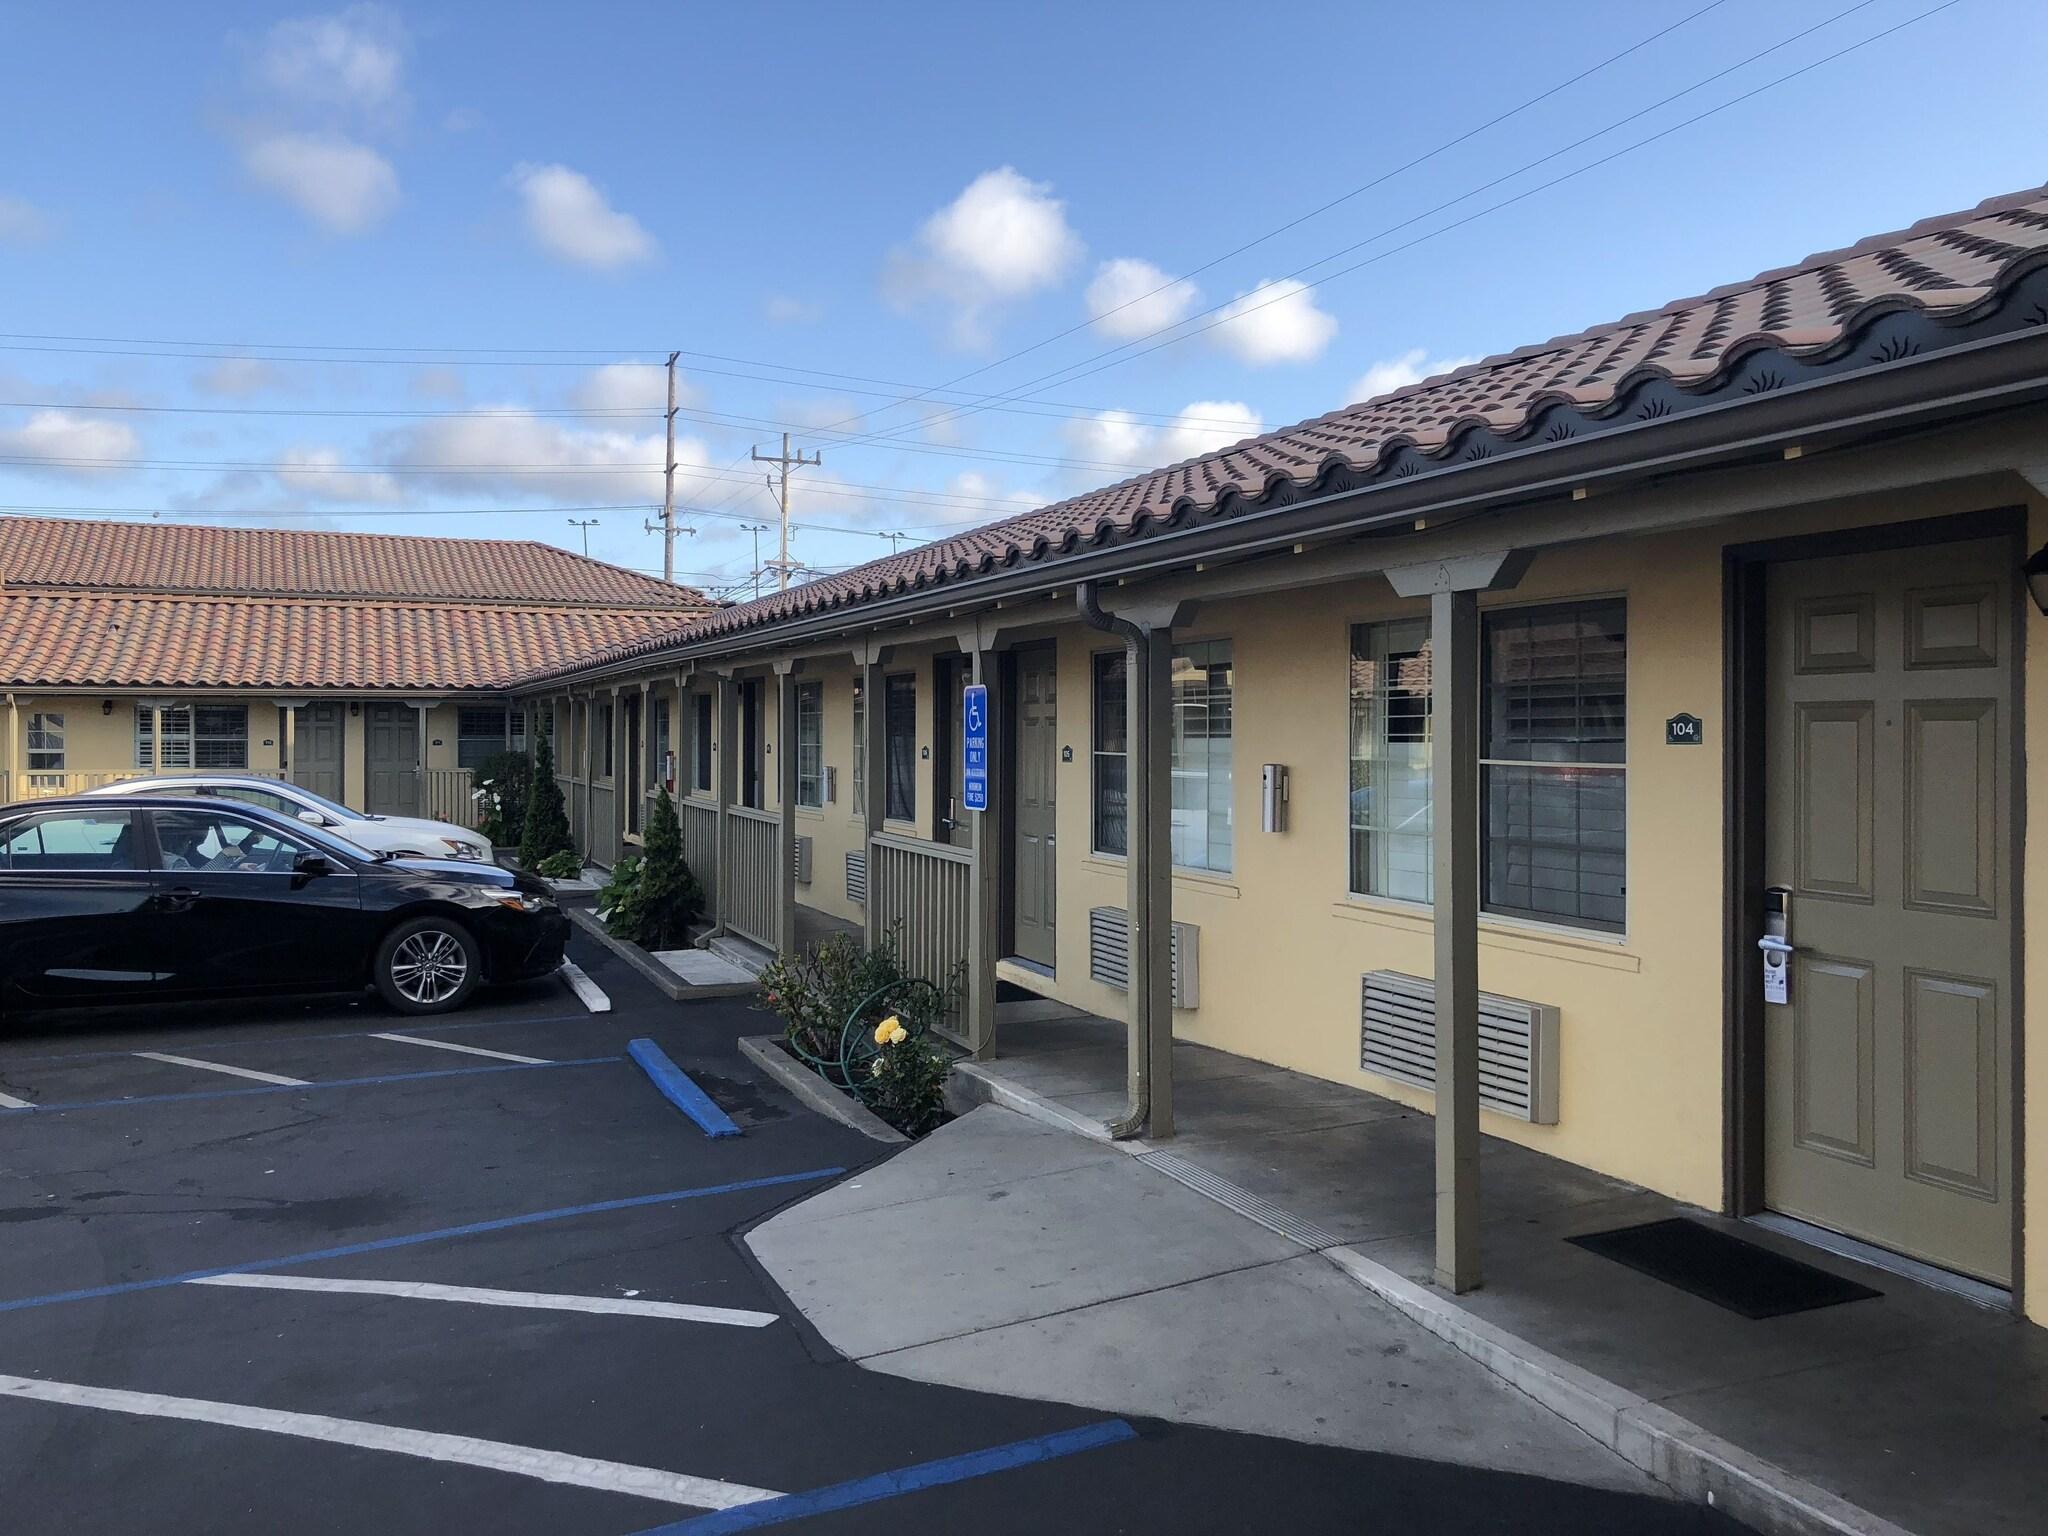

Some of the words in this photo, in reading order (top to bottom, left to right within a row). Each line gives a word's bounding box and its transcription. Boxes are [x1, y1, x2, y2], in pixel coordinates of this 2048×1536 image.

[1672, 722, 1694, 735] 104
[966, 737, 985, 749] PARKING
[969, 751, 981, 763] ONLY
